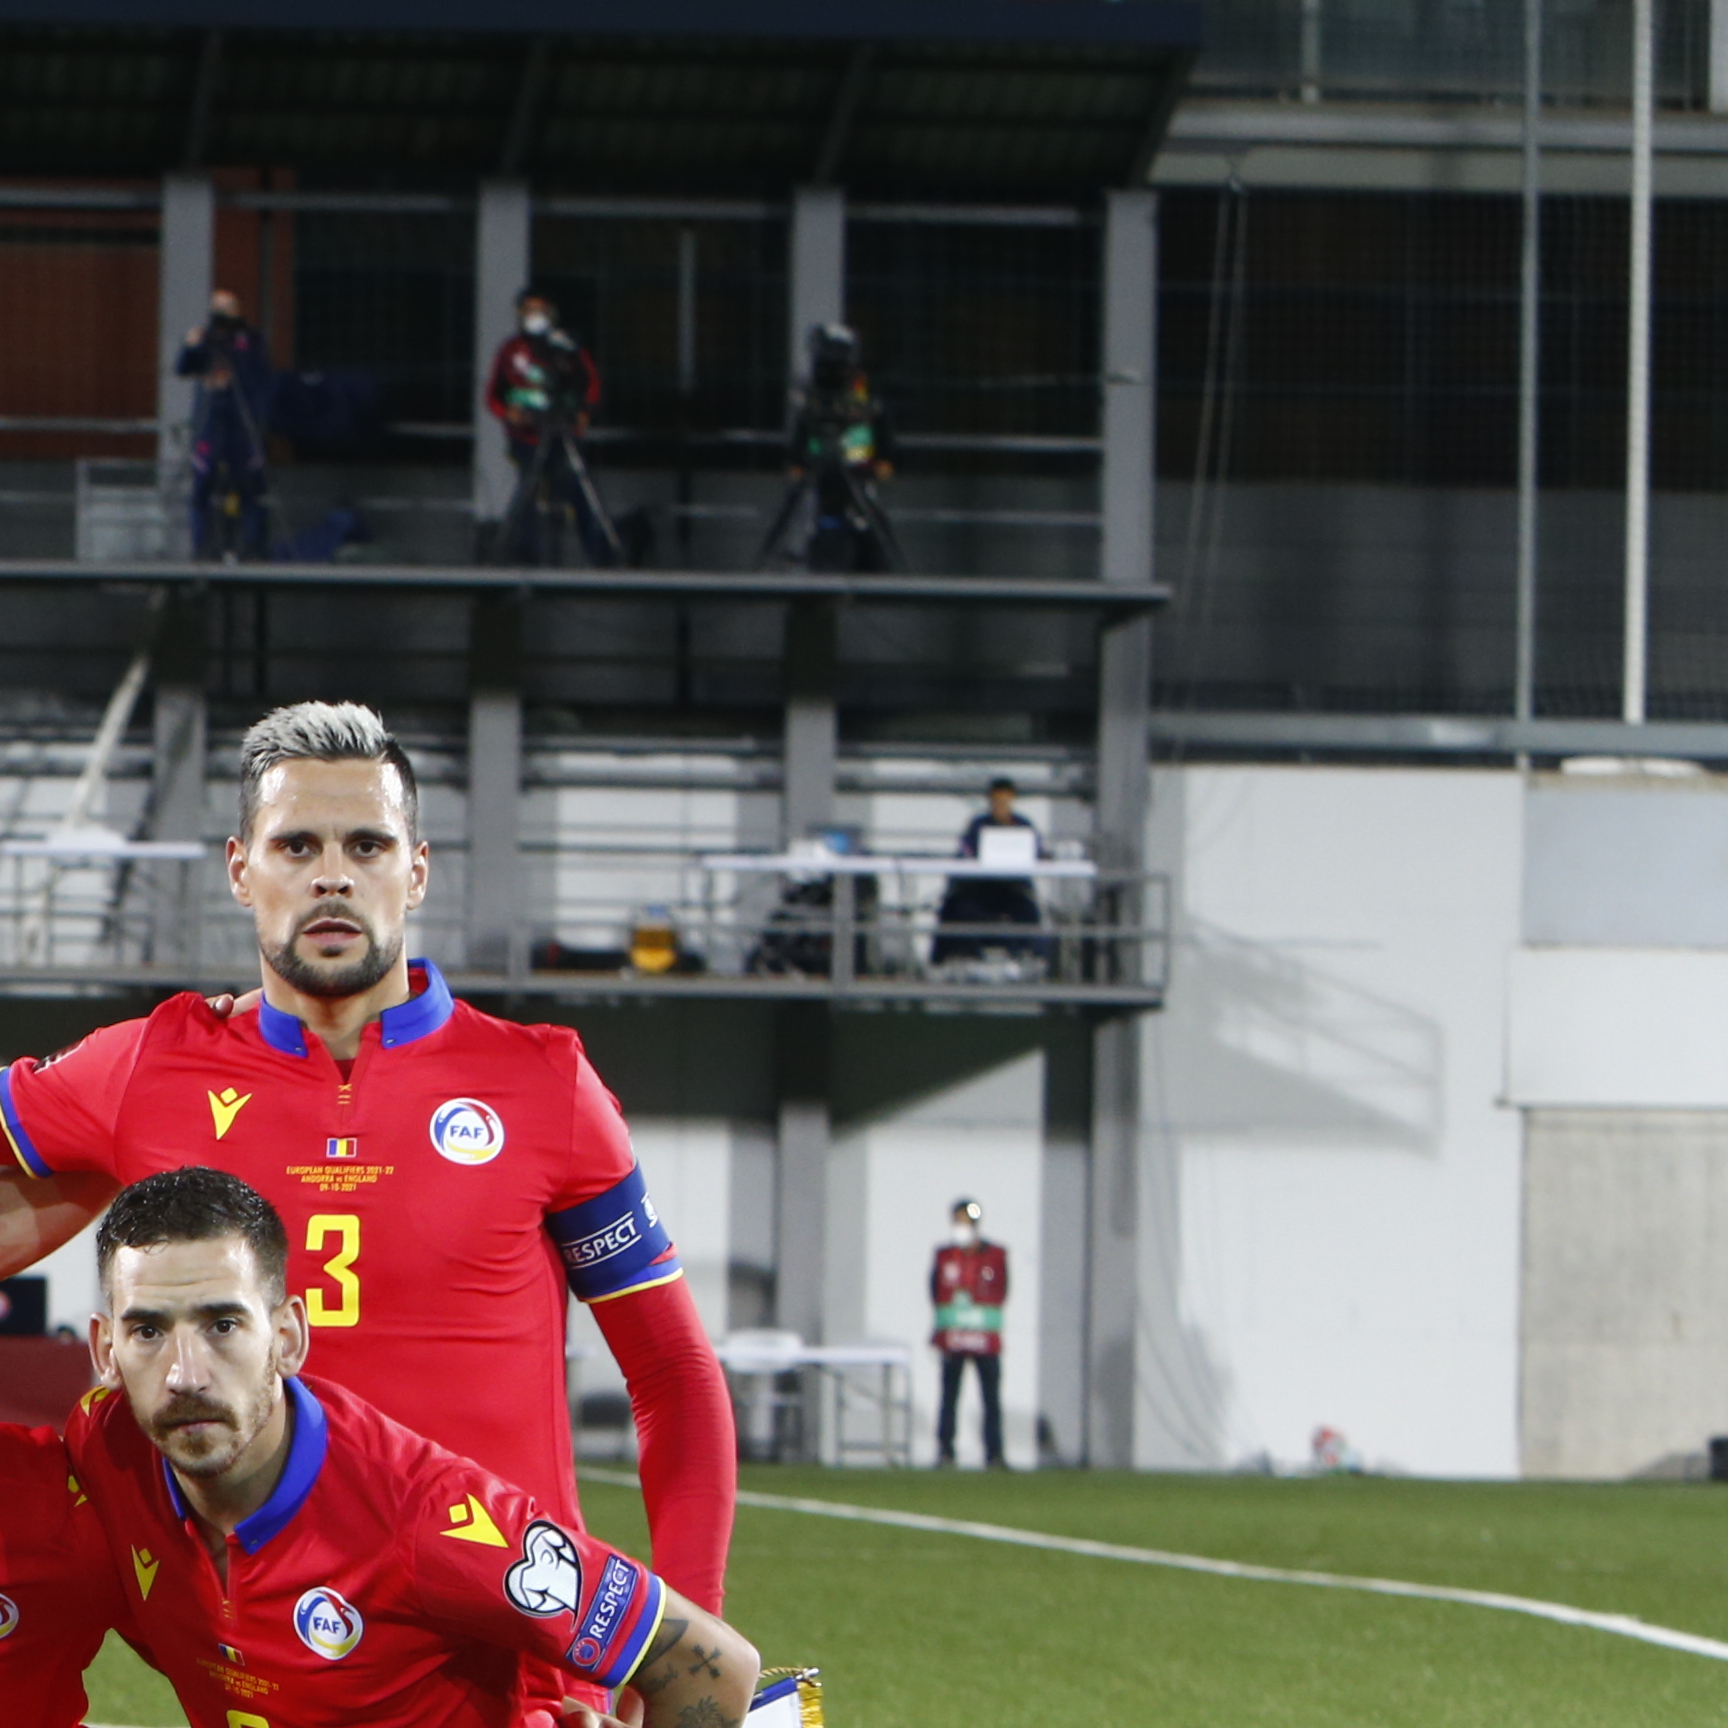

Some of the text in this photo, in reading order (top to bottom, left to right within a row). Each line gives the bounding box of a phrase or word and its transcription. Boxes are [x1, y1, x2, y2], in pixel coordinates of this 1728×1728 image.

[448, 1124, 485, 1140] FAF
[286, 1165, 394, 1175] EUROPEAN QUALIFIERS 2021-22
[300, 1175, 334, 1183] ANDORRA
[344, 1175, 378, 1183] ENGLAND
[319, 1183, 357, 1192] 09-10-2021
[564, 1217, 637, 1263] RESPECT
[305, 1214, 361, 1327] 3
[589, 1559, 630, 1639] RESPECT
[313, 1617, 341, 1633] FAF
